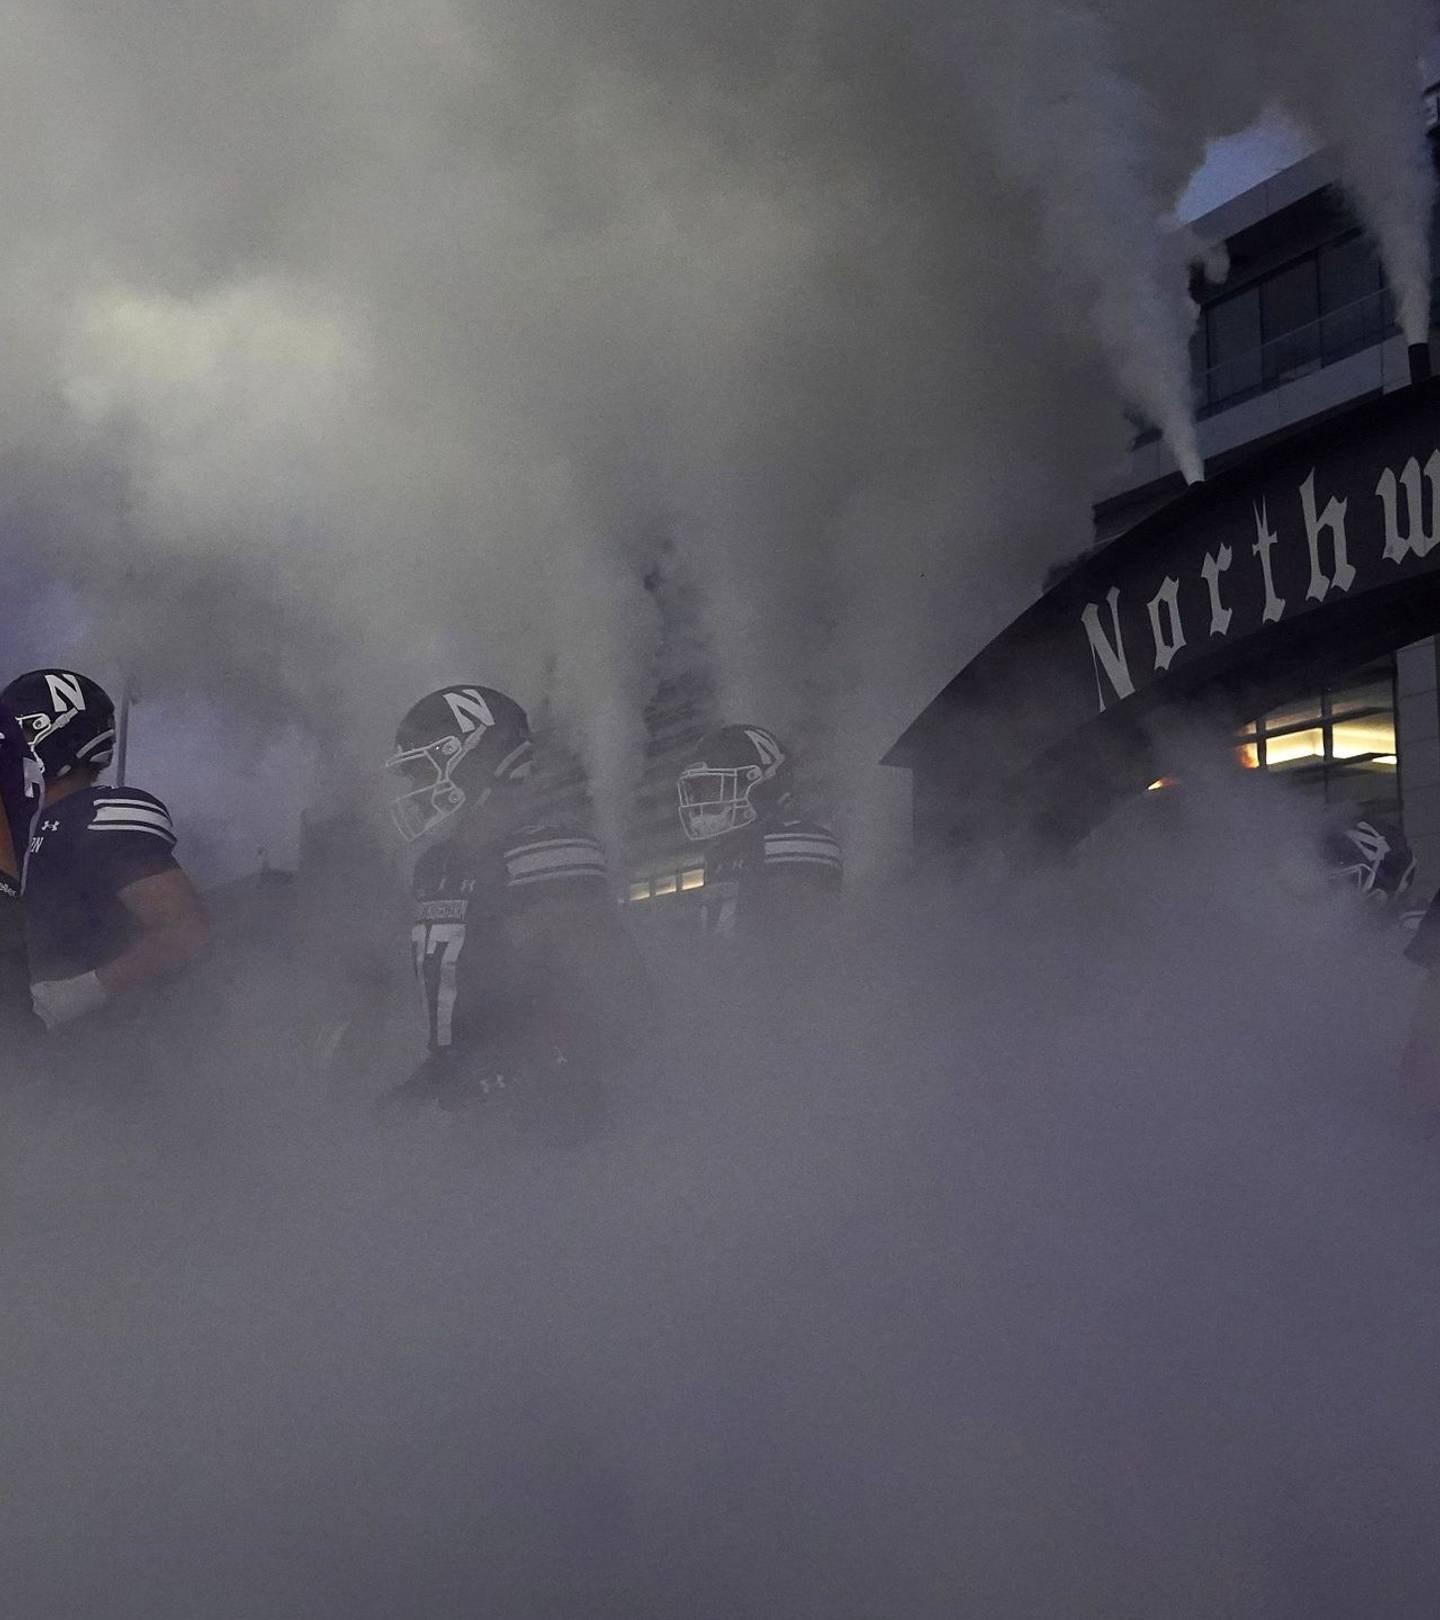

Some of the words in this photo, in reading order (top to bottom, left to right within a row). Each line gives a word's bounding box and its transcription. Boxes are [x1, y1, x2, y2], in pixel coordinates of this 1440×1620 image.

[44, 673, 86, 713] N
[441, 689, 496, 733] N
[411, 923, 467, 1047] 17
